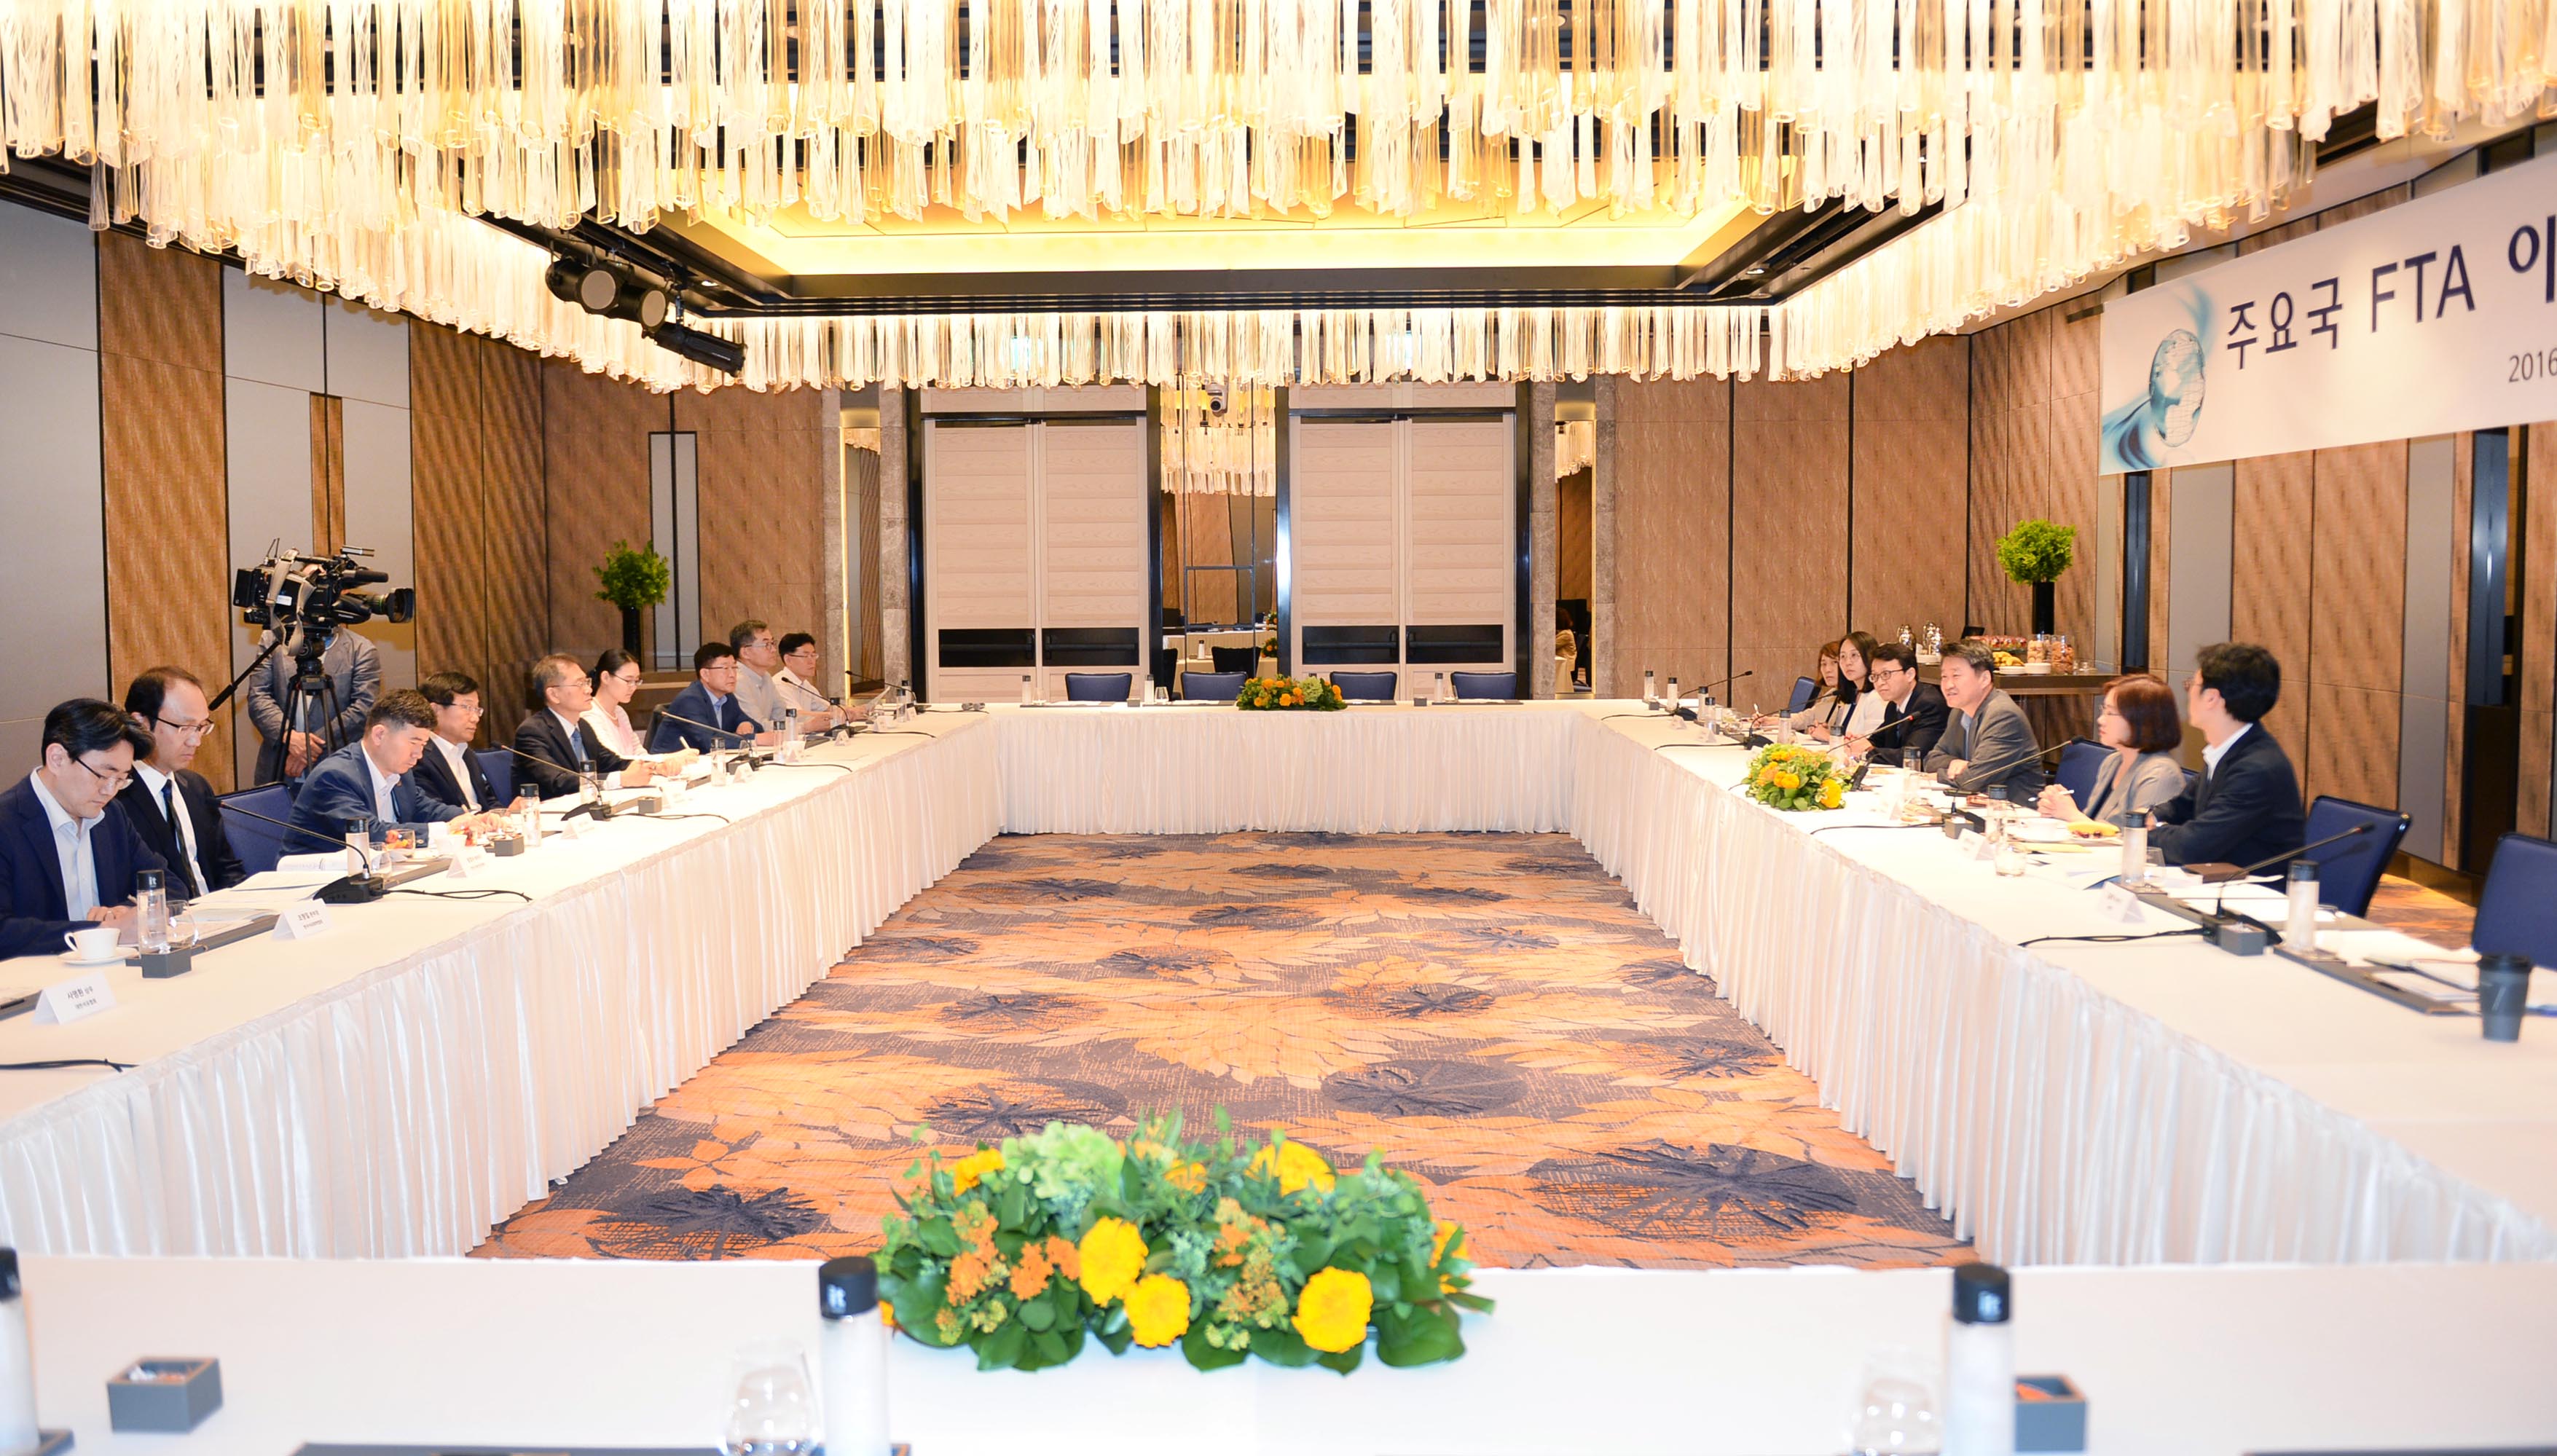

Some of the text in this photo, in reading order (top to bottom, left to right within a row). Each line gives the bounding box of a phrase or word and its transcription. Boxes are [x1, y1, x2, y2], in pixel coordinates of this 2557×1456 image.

[2227, 277, 2343, 369] 주요국
[2372, 244, 2475, 332] FTA
[2509, 347, 2557, 382] 2016
